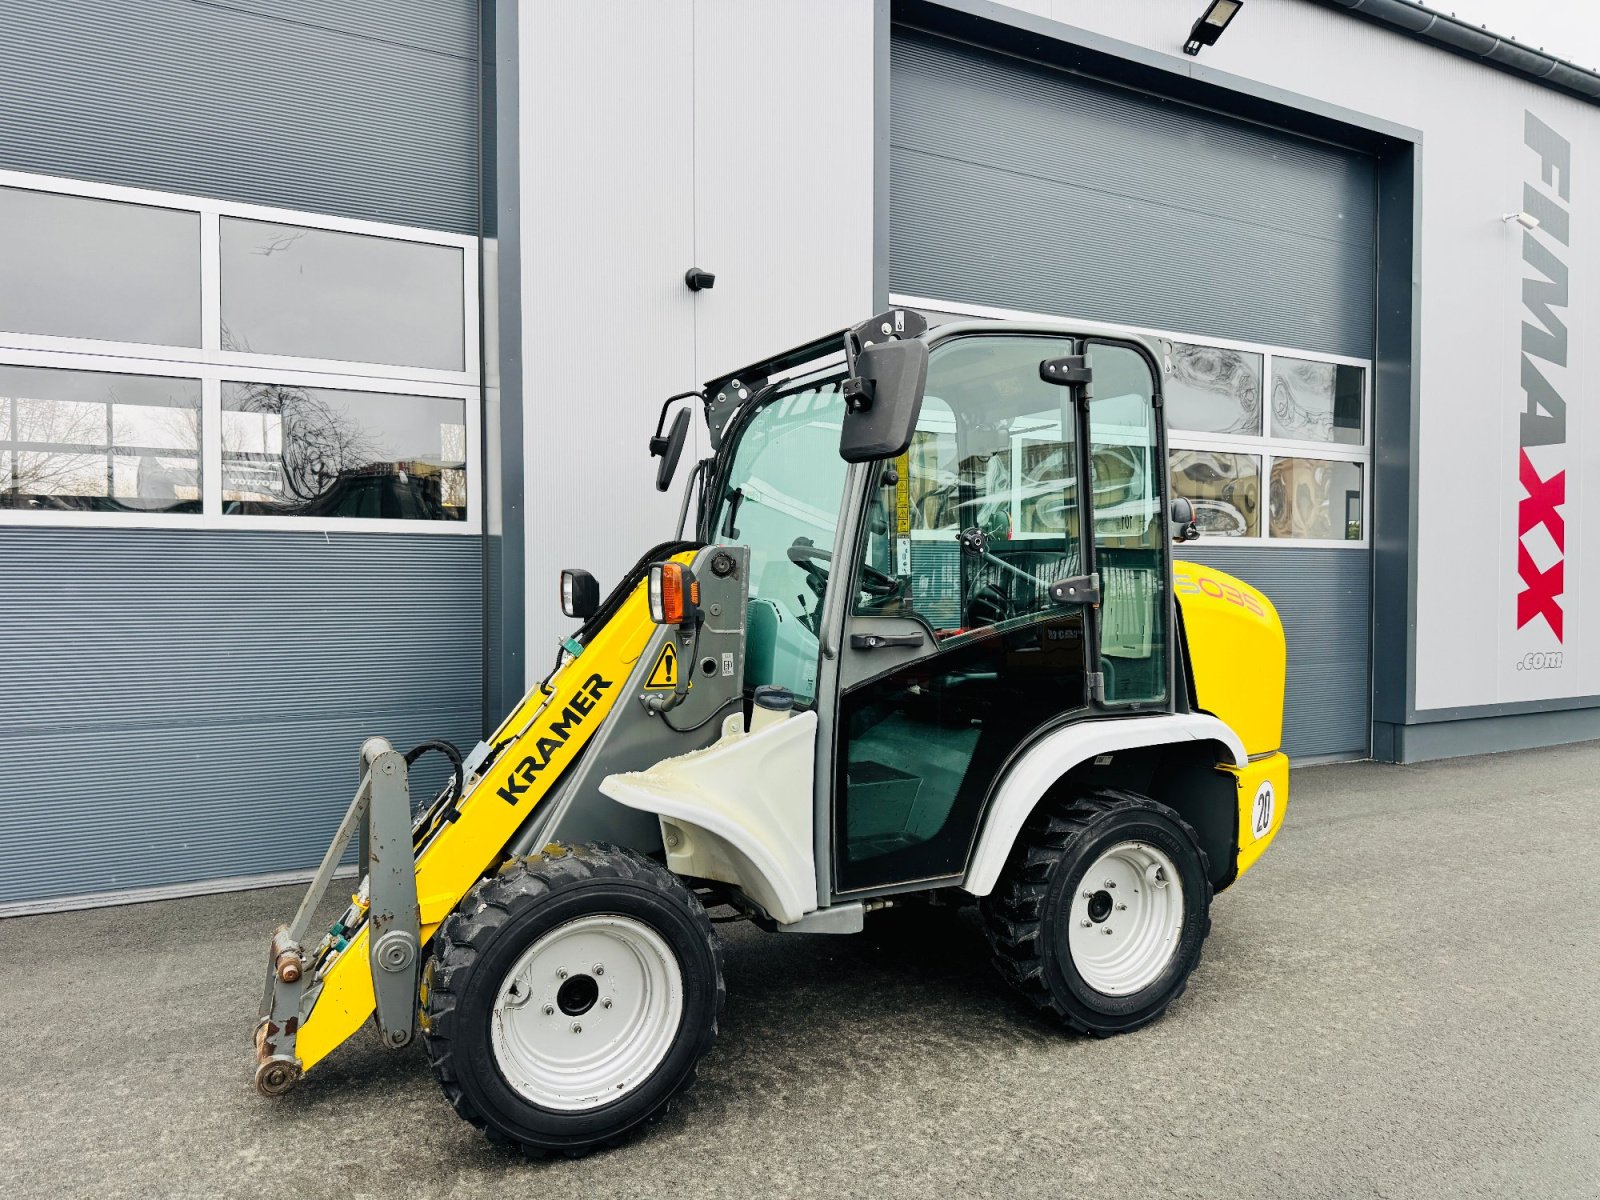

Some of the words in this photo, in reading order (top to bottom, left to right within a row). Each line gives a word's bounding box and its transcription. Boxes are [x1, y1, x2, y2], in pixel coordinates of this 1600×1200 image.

[1517, 108, 1571, 645] FIMAXX
[230, 478, 270, 487] VOLVO
[1516, 651, 1563, 671] .com
[496, 673, 613, 807] KRAMER
[1256, 790, 1271, 833] 20
